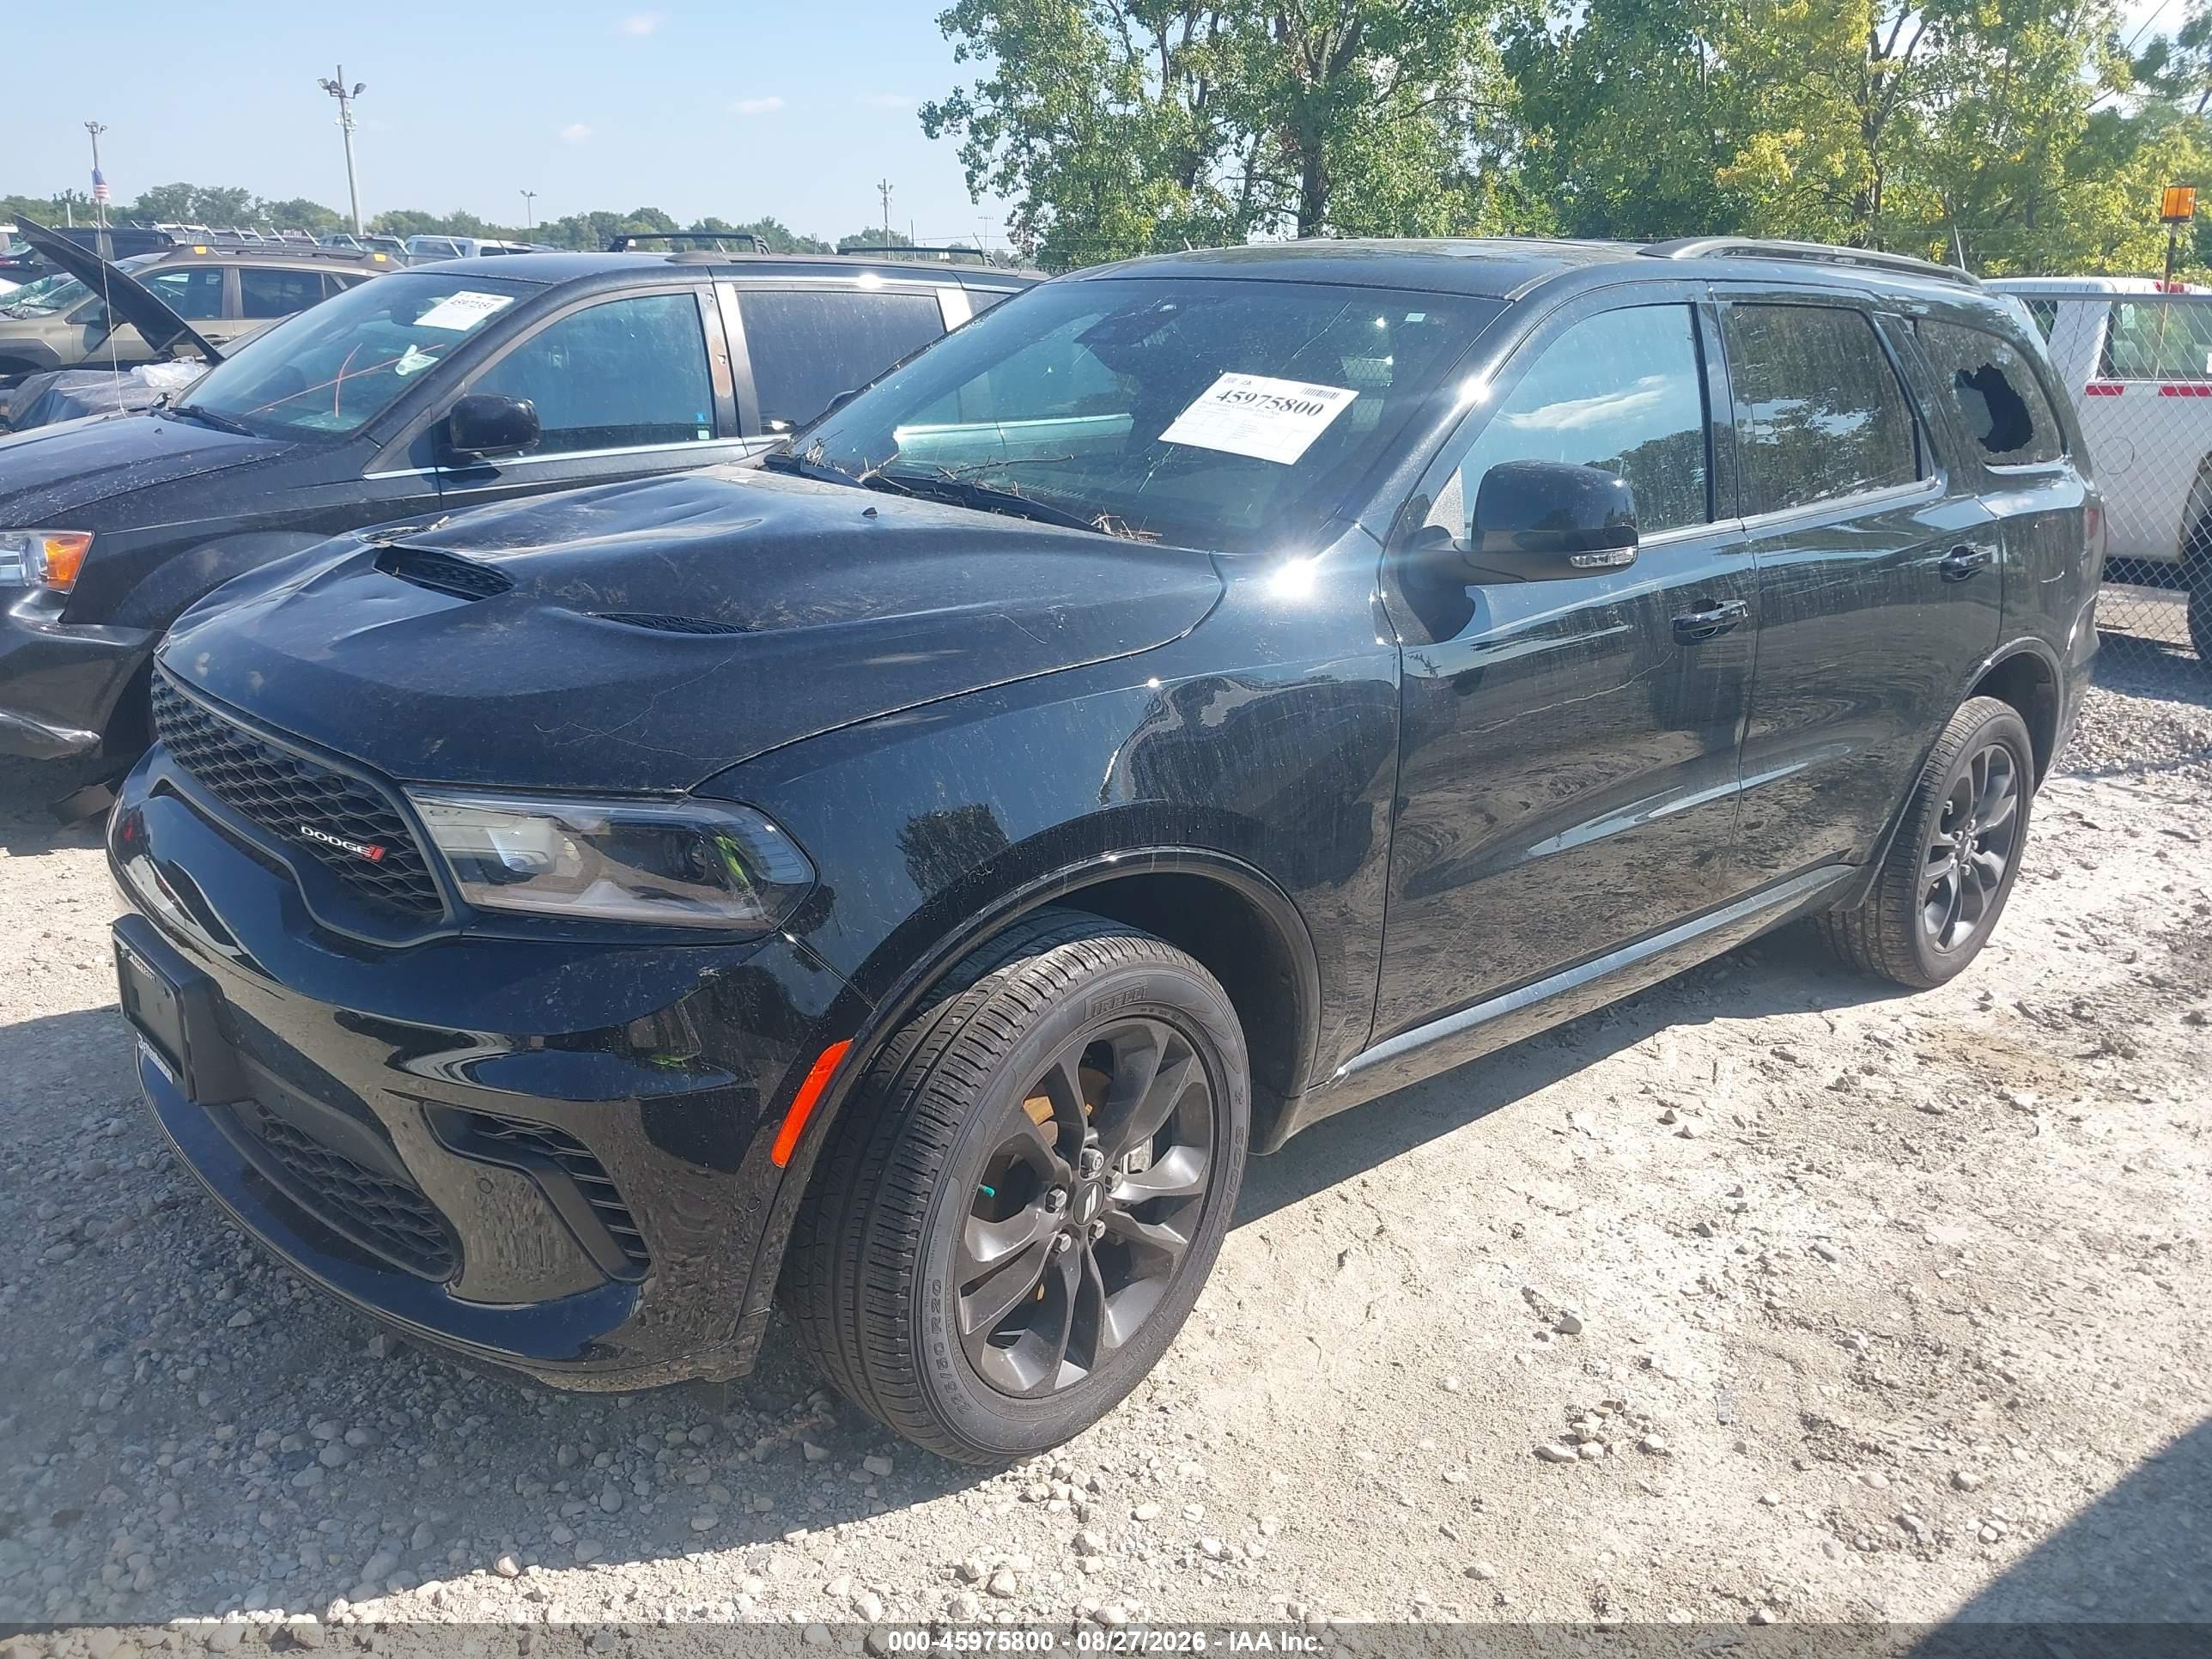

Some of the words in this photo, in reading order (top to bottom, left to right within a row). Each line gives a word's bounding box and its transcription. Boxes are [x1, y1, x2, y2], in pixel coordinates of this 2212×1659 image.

[1216, 389, 1324, 417] 45975800
[301, 825, 372, 857] DODGE
[931, 1279, 942, 1334] R20
